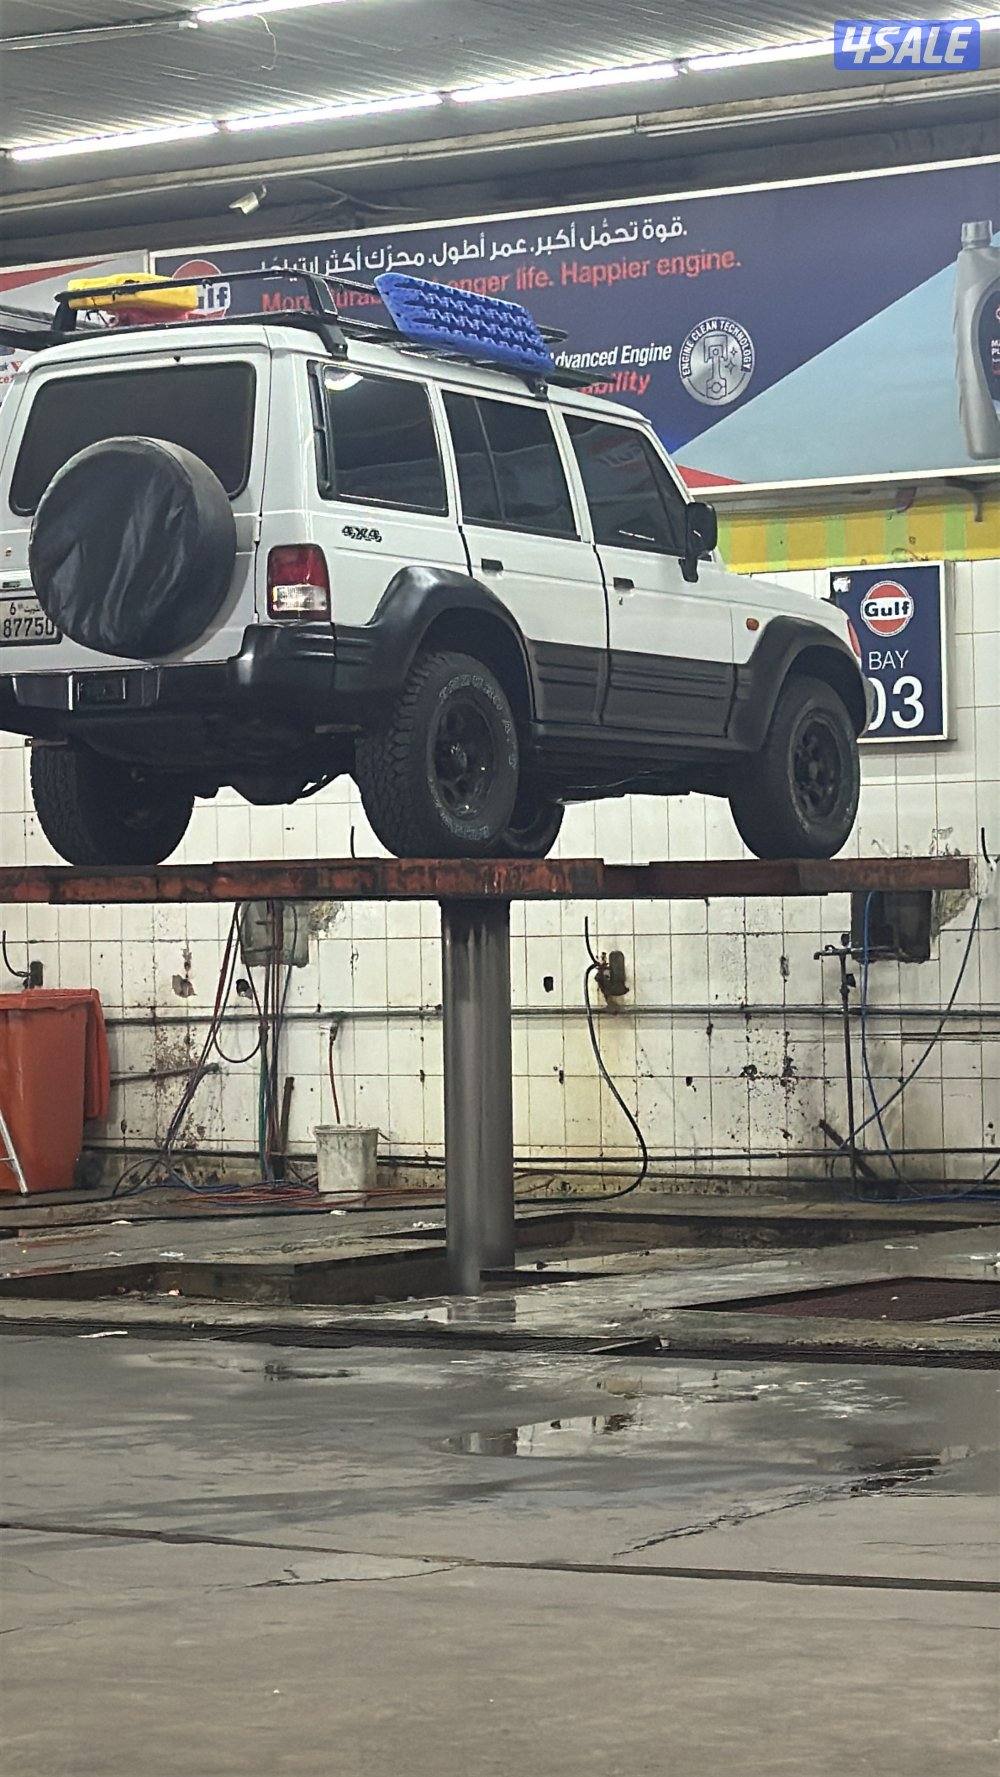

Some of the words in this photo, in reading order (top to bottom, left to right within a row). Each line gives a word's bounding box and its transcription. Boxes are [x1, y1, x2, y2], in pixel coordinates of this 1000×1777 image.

[489, 239, 527, 262] عمر
[262, 291, 312, 312] Mor
[516, 266, 554, 291] life.
[560, 257, 650, 289] Happier
[656, 249, 741, 278] engine.
[550, 346, 618, 369] dvanced
[620, 342, 673, 369] Engine
[682, 340, 695, 376] ENGINE
[691, 320, 718, 341] CLEAN
[720, 320, 752, 370] TECHNOLOGY
[10, 602, 16, 615] 6
[864, 600, 910, 618] Gulf
[3, 617, 55, 638] 87750
[868, 650, 909, 671] BAY
